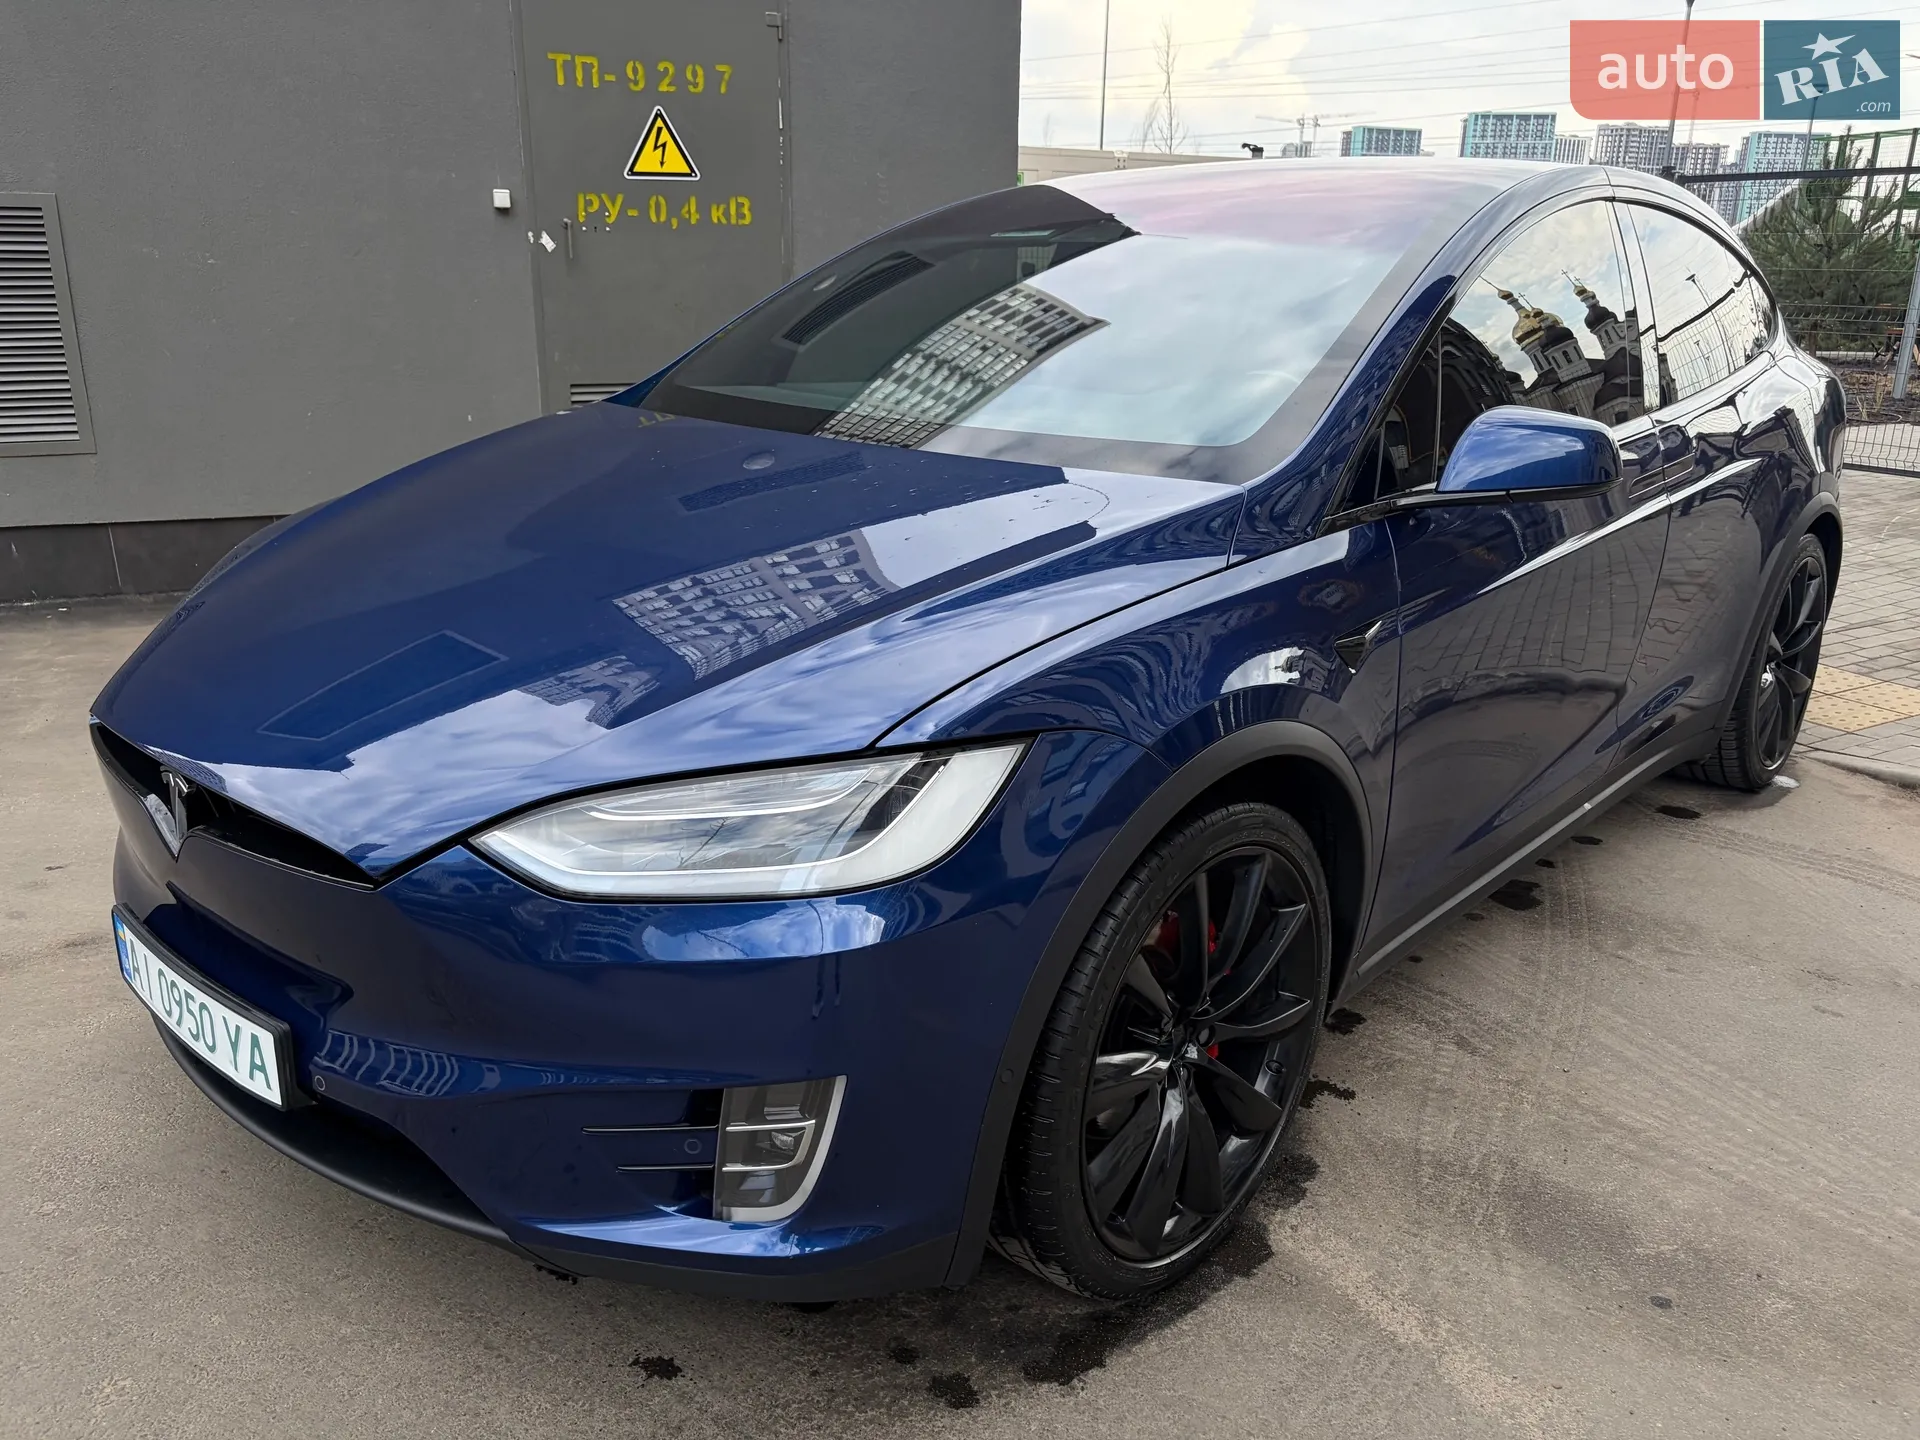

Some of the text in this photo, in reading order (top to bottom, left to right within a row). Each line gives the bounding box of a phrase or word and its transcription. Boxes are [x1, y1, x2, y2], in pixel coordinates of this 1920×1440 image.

[711, 196, 752, 225] кВ
[129, 937, 153, 1001] AI
[157, 967, 217, 1055] 0950
[222, 1014, 272, 1091] YA
